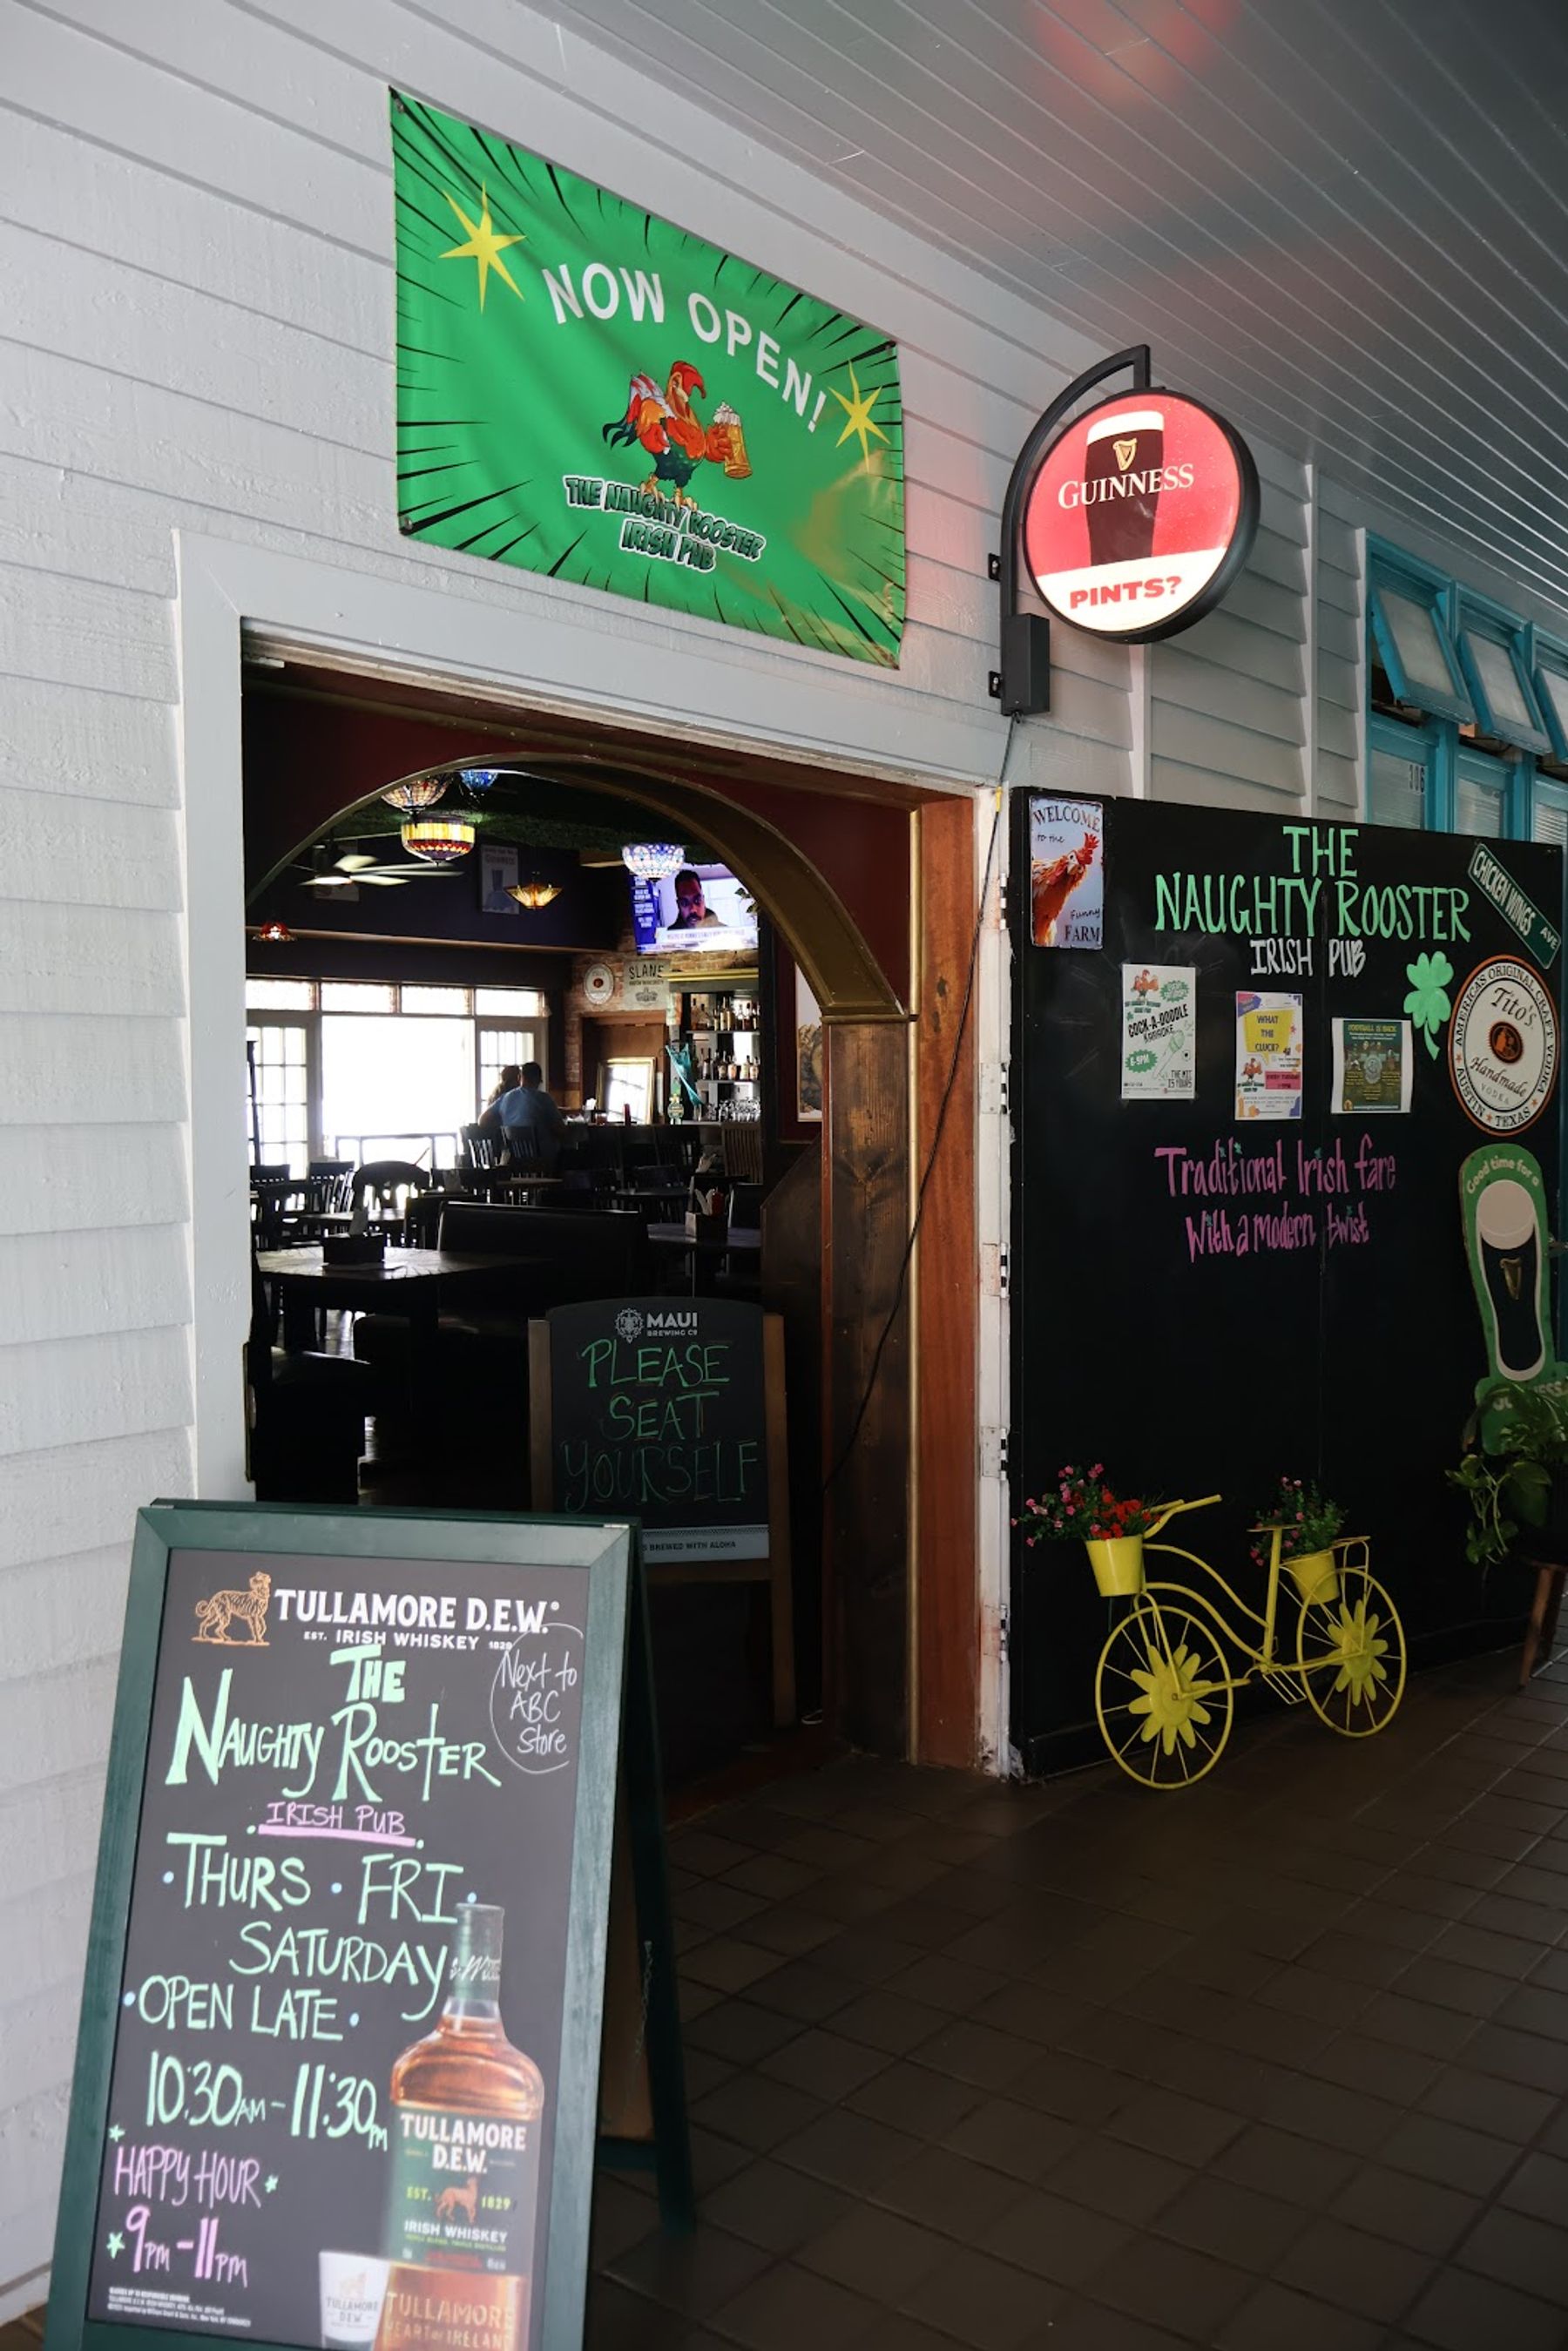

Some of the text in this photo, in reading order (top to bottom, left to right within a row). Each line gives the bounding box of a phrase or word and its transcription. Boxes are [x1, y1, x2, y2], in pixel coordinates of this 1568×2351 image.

[542, 263, 828, 433] NOW OPEN!
[1058, 463, 1194, 510] GUINNESS
[564, 476, 765, 559] THE NAUGHTY ROOSTER
[621, 521, 714, 571] IRISH PUB
[1069, 576, 1182, 609] PINTS?
[1033, 805, 1101, 833] WELCOME
[1282, 826, 1359, 877] THE
[1071, 908, 1100, 922] Funny
[1154, 872, 1471, 942] NAUGHTY ROOSTER
[1473, 851, 1558, 949] CHICKEN WINGS AVE
[1064, 924, 1101, 942] FARM
[629, 964, 664, 979] SLANE
[1250, 938, 1367, 978] IRISH PUB
[1490, 987, 1537, 1028] Tito's
[1260, 1029, 1274, 1037] THE
[1455, 965, 1554, 1093] AMERICA'S ORIGINAL CRAFT VODKA
[1456, 1068, 1531, 1127] AUSTIN TEXAS
[1470, 1056, 1528, 1098] Handmade
[1154, 1132, 1396, 1197] Traditional Irish fare
[1466, 1155, 1539, 1194] Good time for a
[1254, 1201, 1316, 1253] modern
[1328, 1201, 1369, 1248] twist
[646, 1312, 697, 1328] MAUI
[581, 1338, 730, 1388] PLEASE
[610, 1391, 719, 1440] SEAT
[560, 1440, 758, 1513] YOURSELF
[649, 1543, 683, 1551] BREWED
[274, 1589, 550, 1634] TULLAMORE D.E.W.
[304, 1632, 328, 1641] EST.
[335, 1629, 387, 1645] IRISH
[394, 1632, 480, 1650] WHISKEY
[330, 1643, 406, 1702] THE
[500, 1651, 578, 1692] Next to
[510, 1686, 562, 1725] ABC
[165, 1668, 502, 1803] NAUGHTY ROOSTER
[517, 1726, 568, 1756] Store
[266, 1800, 406, 1835] IRISH PUB
[166, 1833, 465, 1925] THURS FRI
[228, 1921, 449, 2022] SATURDAY
[138, 1975, 343, 2042] OPEN LATE
[400, 2113, 526, 2152] TULLAMORE
[114, 2145, 261, 2210] HAPPY HOUR
[431, 2144, 488, 2173] D.E.W.
[406, 2186, 511, 2211] EST. 1829
[404, 2220, 508, 2243] IRISH WHISKEY
[328, 2297, 378, 2312] TULLAMORE
